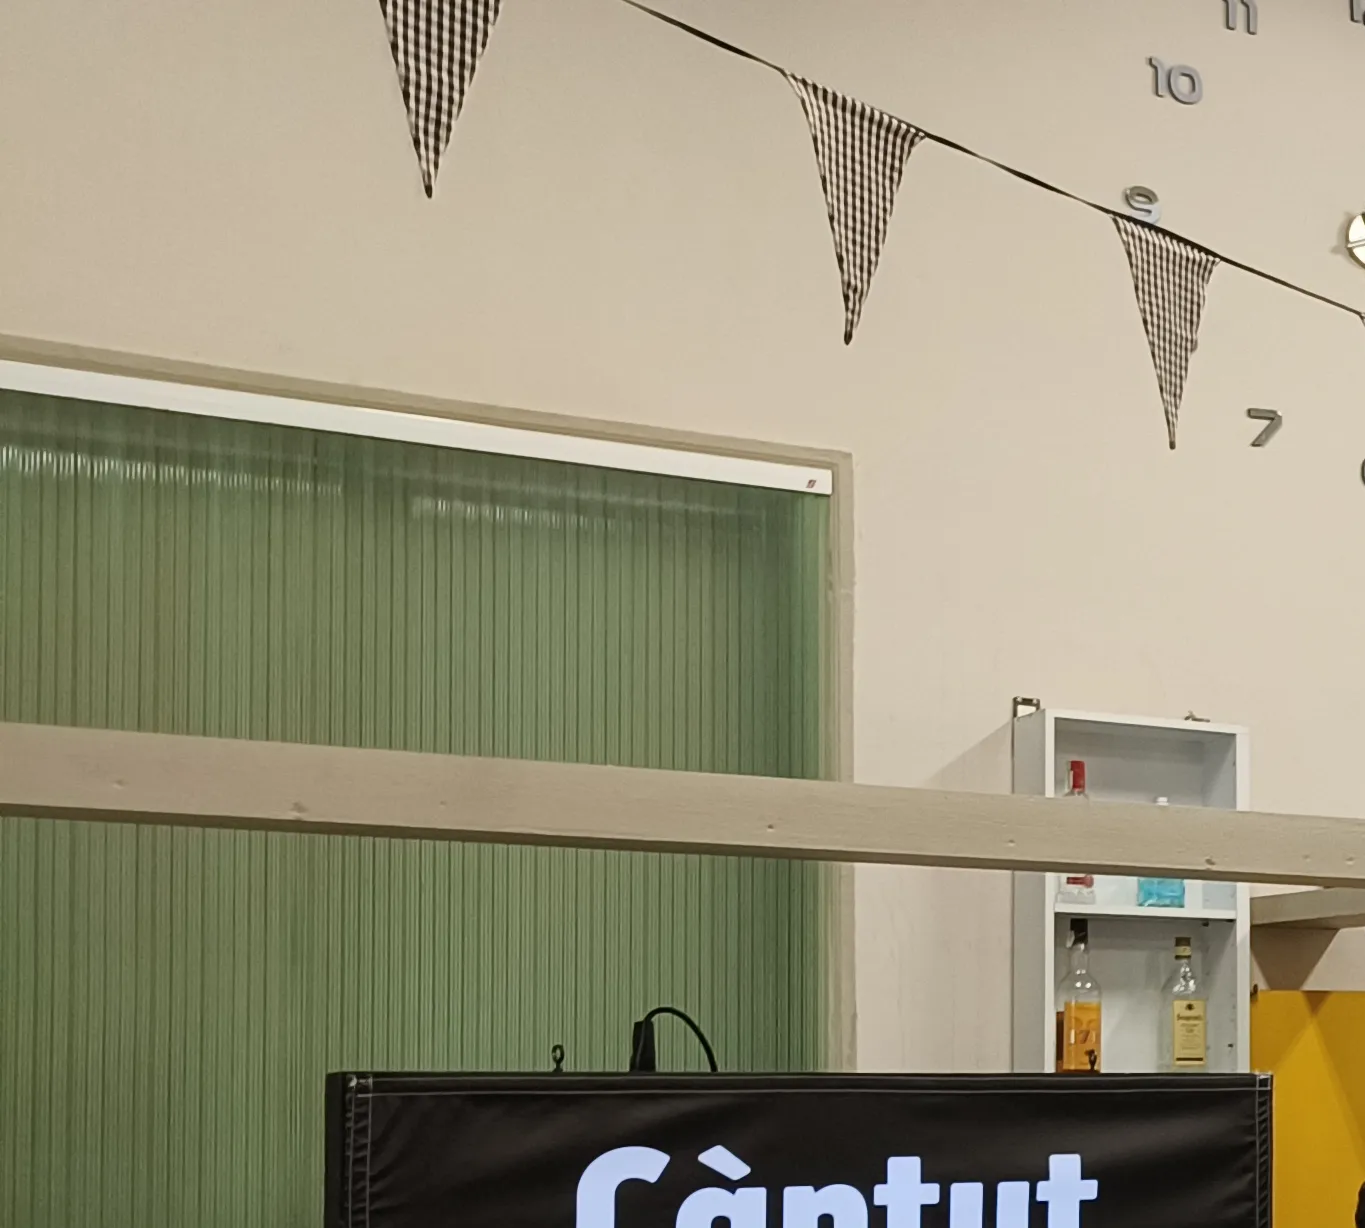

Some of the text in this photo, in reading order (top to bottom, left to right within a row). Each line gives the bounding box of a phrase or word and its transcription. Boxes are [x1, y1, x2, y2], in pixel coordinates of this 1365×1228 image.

[1222, 0, 1257, 34] 11
[1148, 56, 1203, 105] 10
[1123, 185, 1161, 225] 9
[1246, 407, 1282, 447] 7
